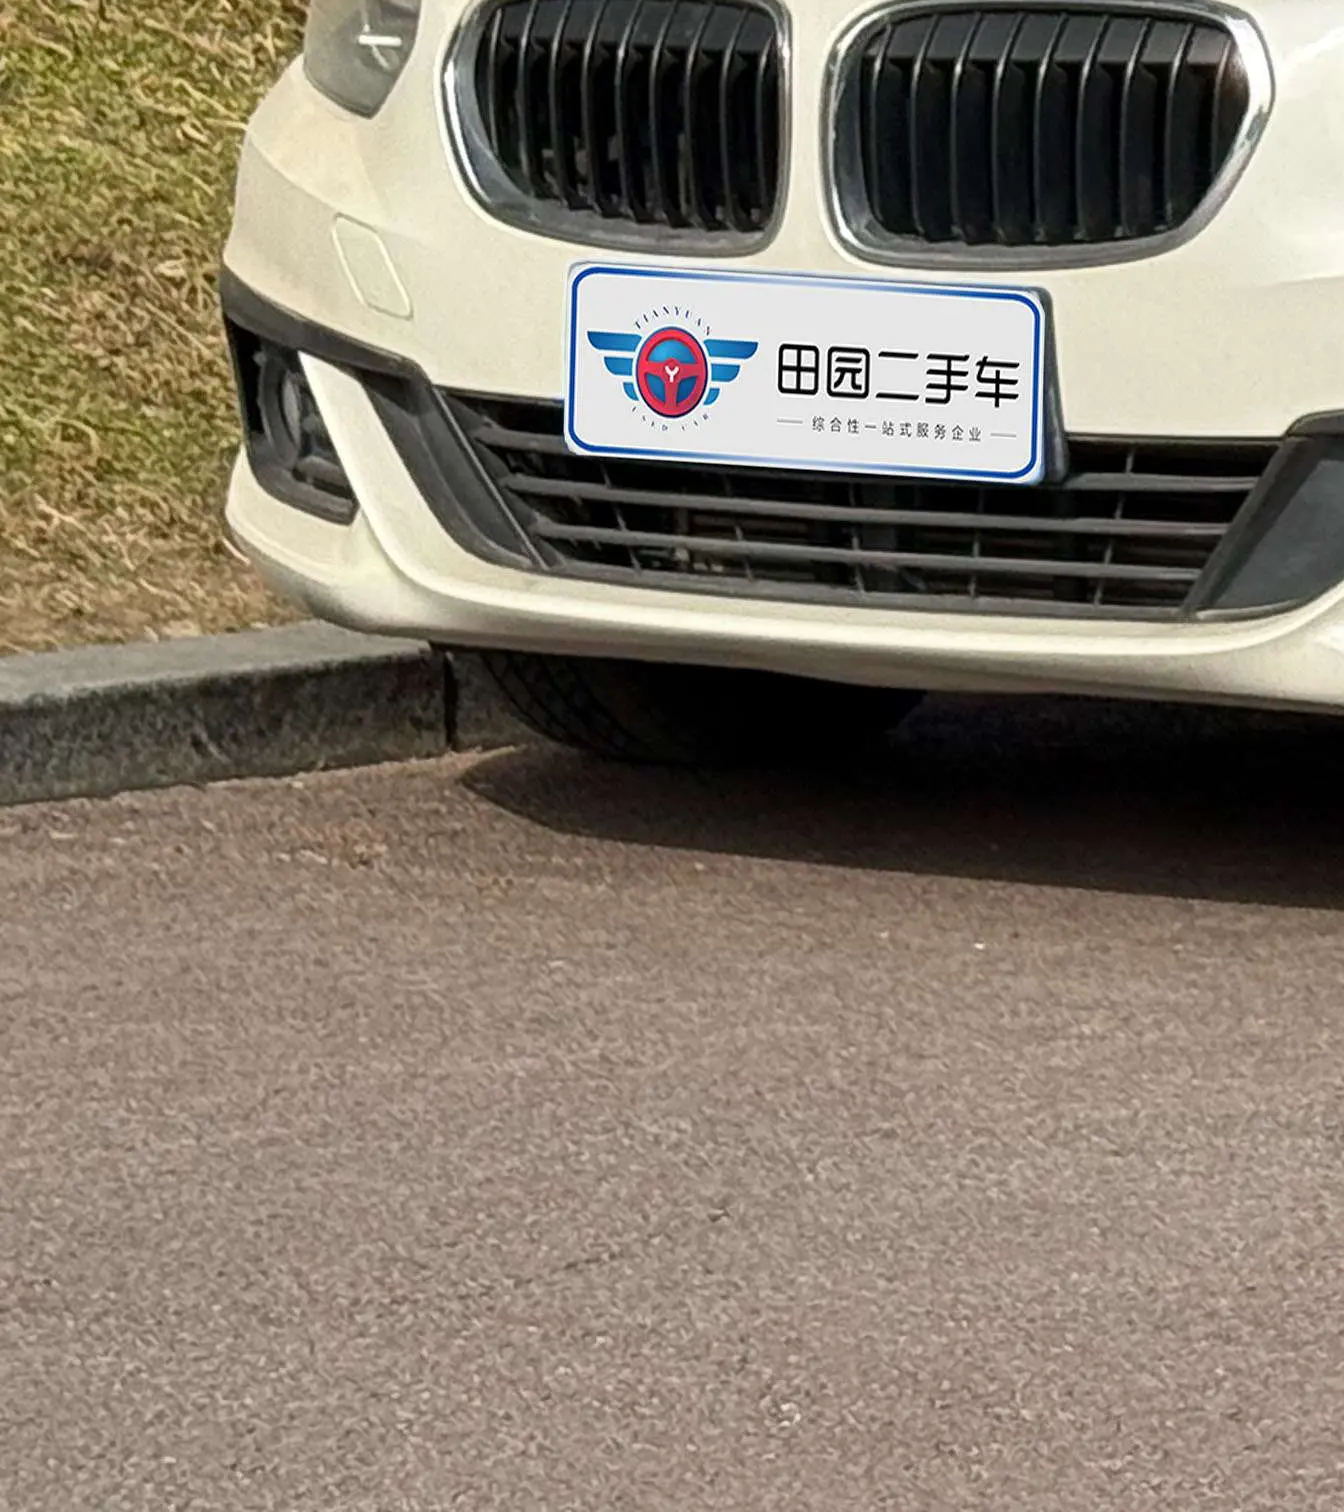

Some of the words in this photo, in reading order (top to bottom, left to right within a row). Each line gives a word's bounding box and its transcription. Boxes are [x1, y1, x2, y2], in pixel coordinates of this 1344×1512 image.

[778, 344, 1019, 407] 田园二手车
[813, 417, 980, 441] 综合性一站式服务企业
